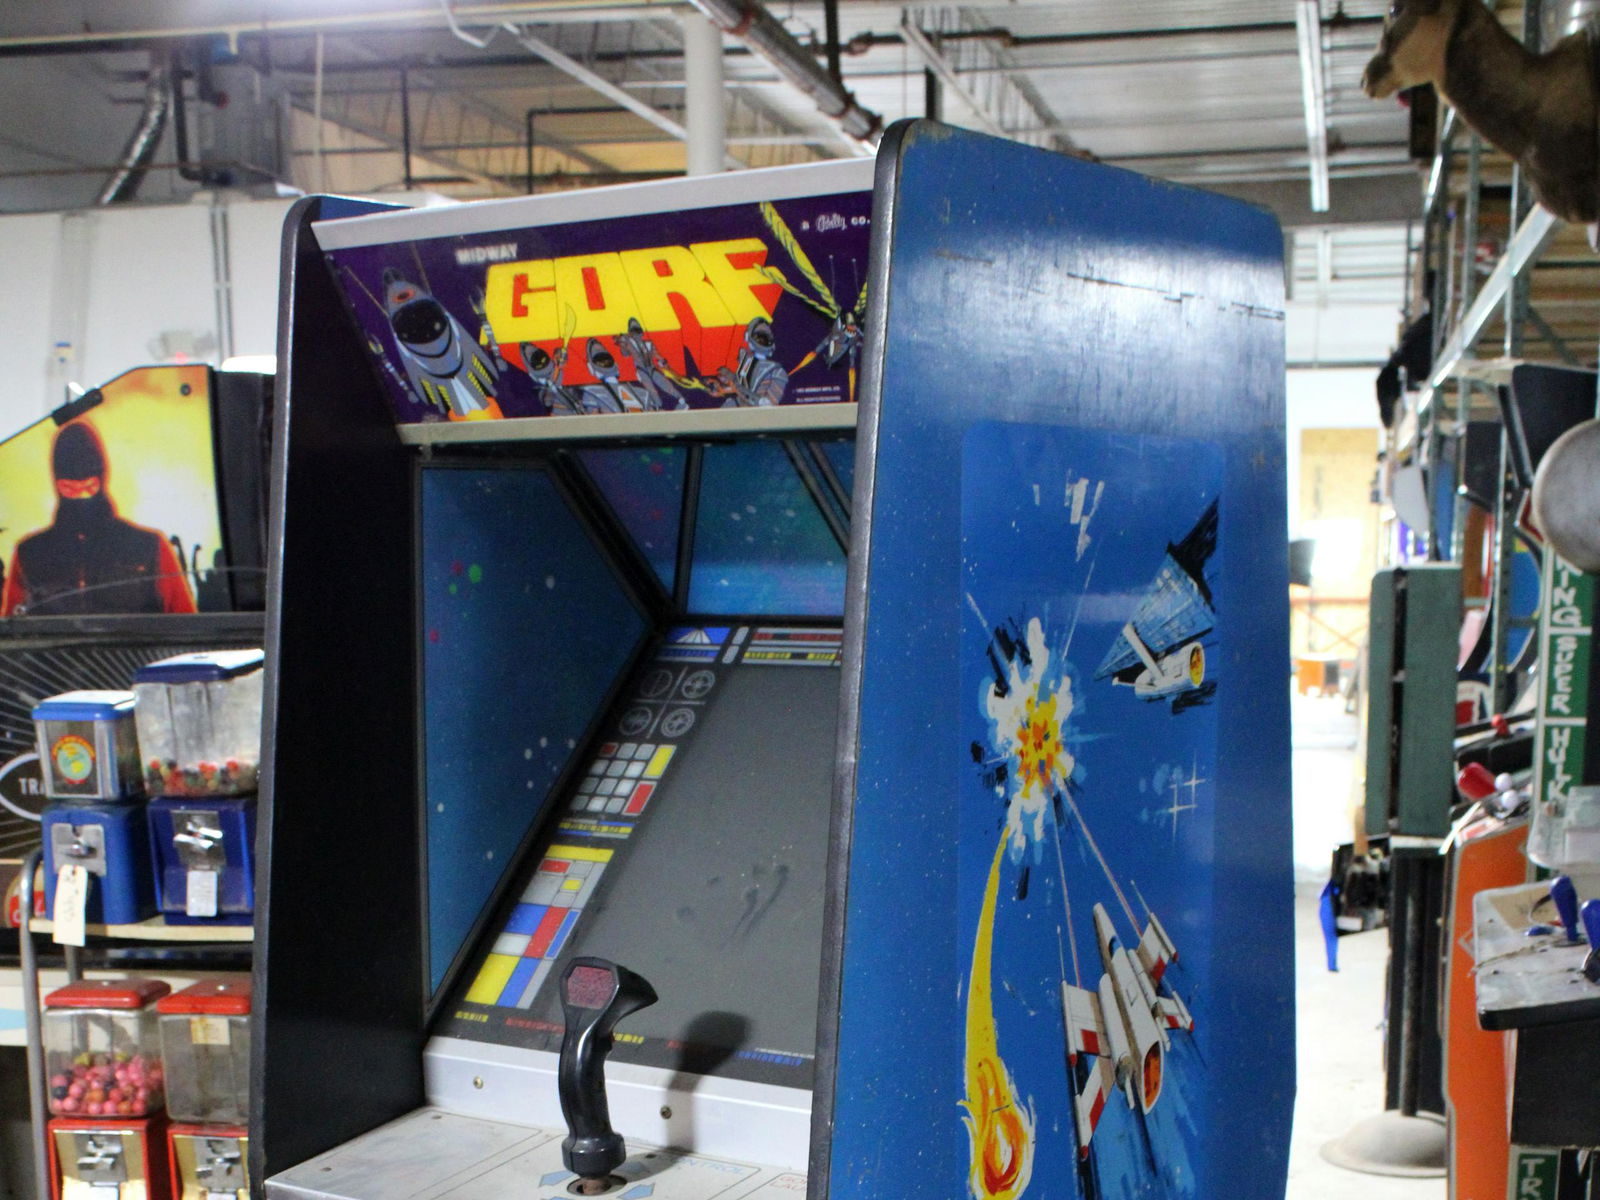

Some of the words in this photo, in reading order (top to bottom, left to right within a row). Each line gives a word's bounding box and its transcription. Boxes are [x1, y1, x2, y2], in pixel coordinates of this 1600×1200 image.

[456, 242, 518, 265] MIDWAY
[479, 237, 785, 346] GORF
[1551, 635, 1578, 715] SUPER
